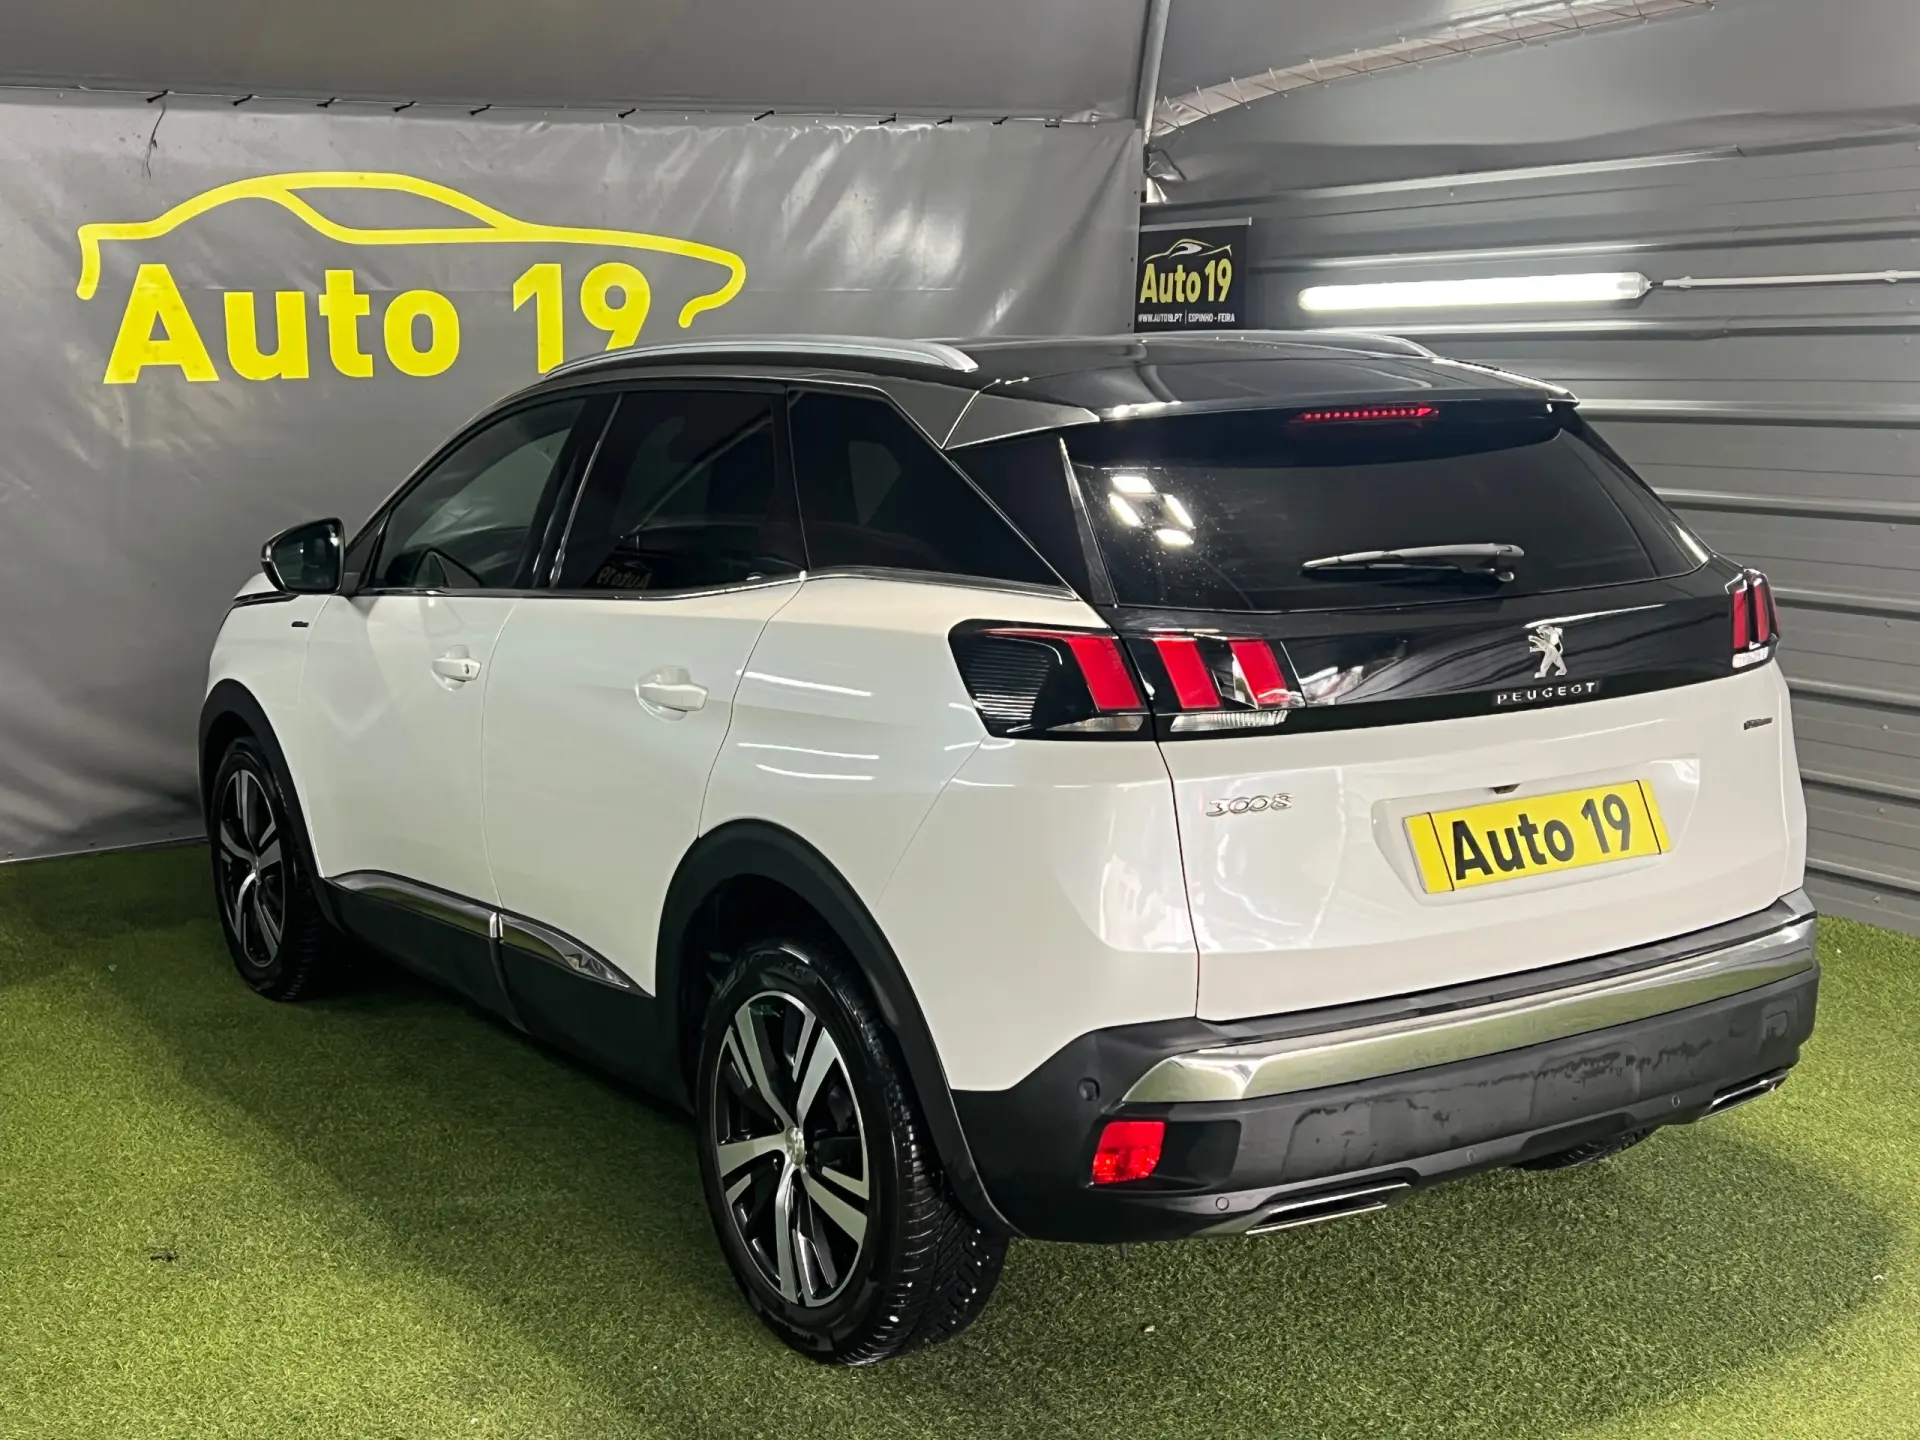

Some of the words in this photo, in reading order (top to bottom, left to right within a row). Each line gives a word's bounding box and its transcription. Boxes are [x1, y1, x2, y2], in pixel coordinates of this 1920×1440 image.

[1139, 263, 1201, 303] Auto
[1204, 258, 1232, 302] 19
[103, 263, 460, 384] Auto
[512, 262, 651, 374] 19
[1188, 312, 1214, 323] ESPINHO
[1218, 312, 1236, 322] FEIRA
[1497, 682, 1596, 704] PEUGEOT
[1206, 792, 1294, 817] 3008
[1452, 813, 1575, 880] Auto
[1580, 793, 1631, 854] 19
